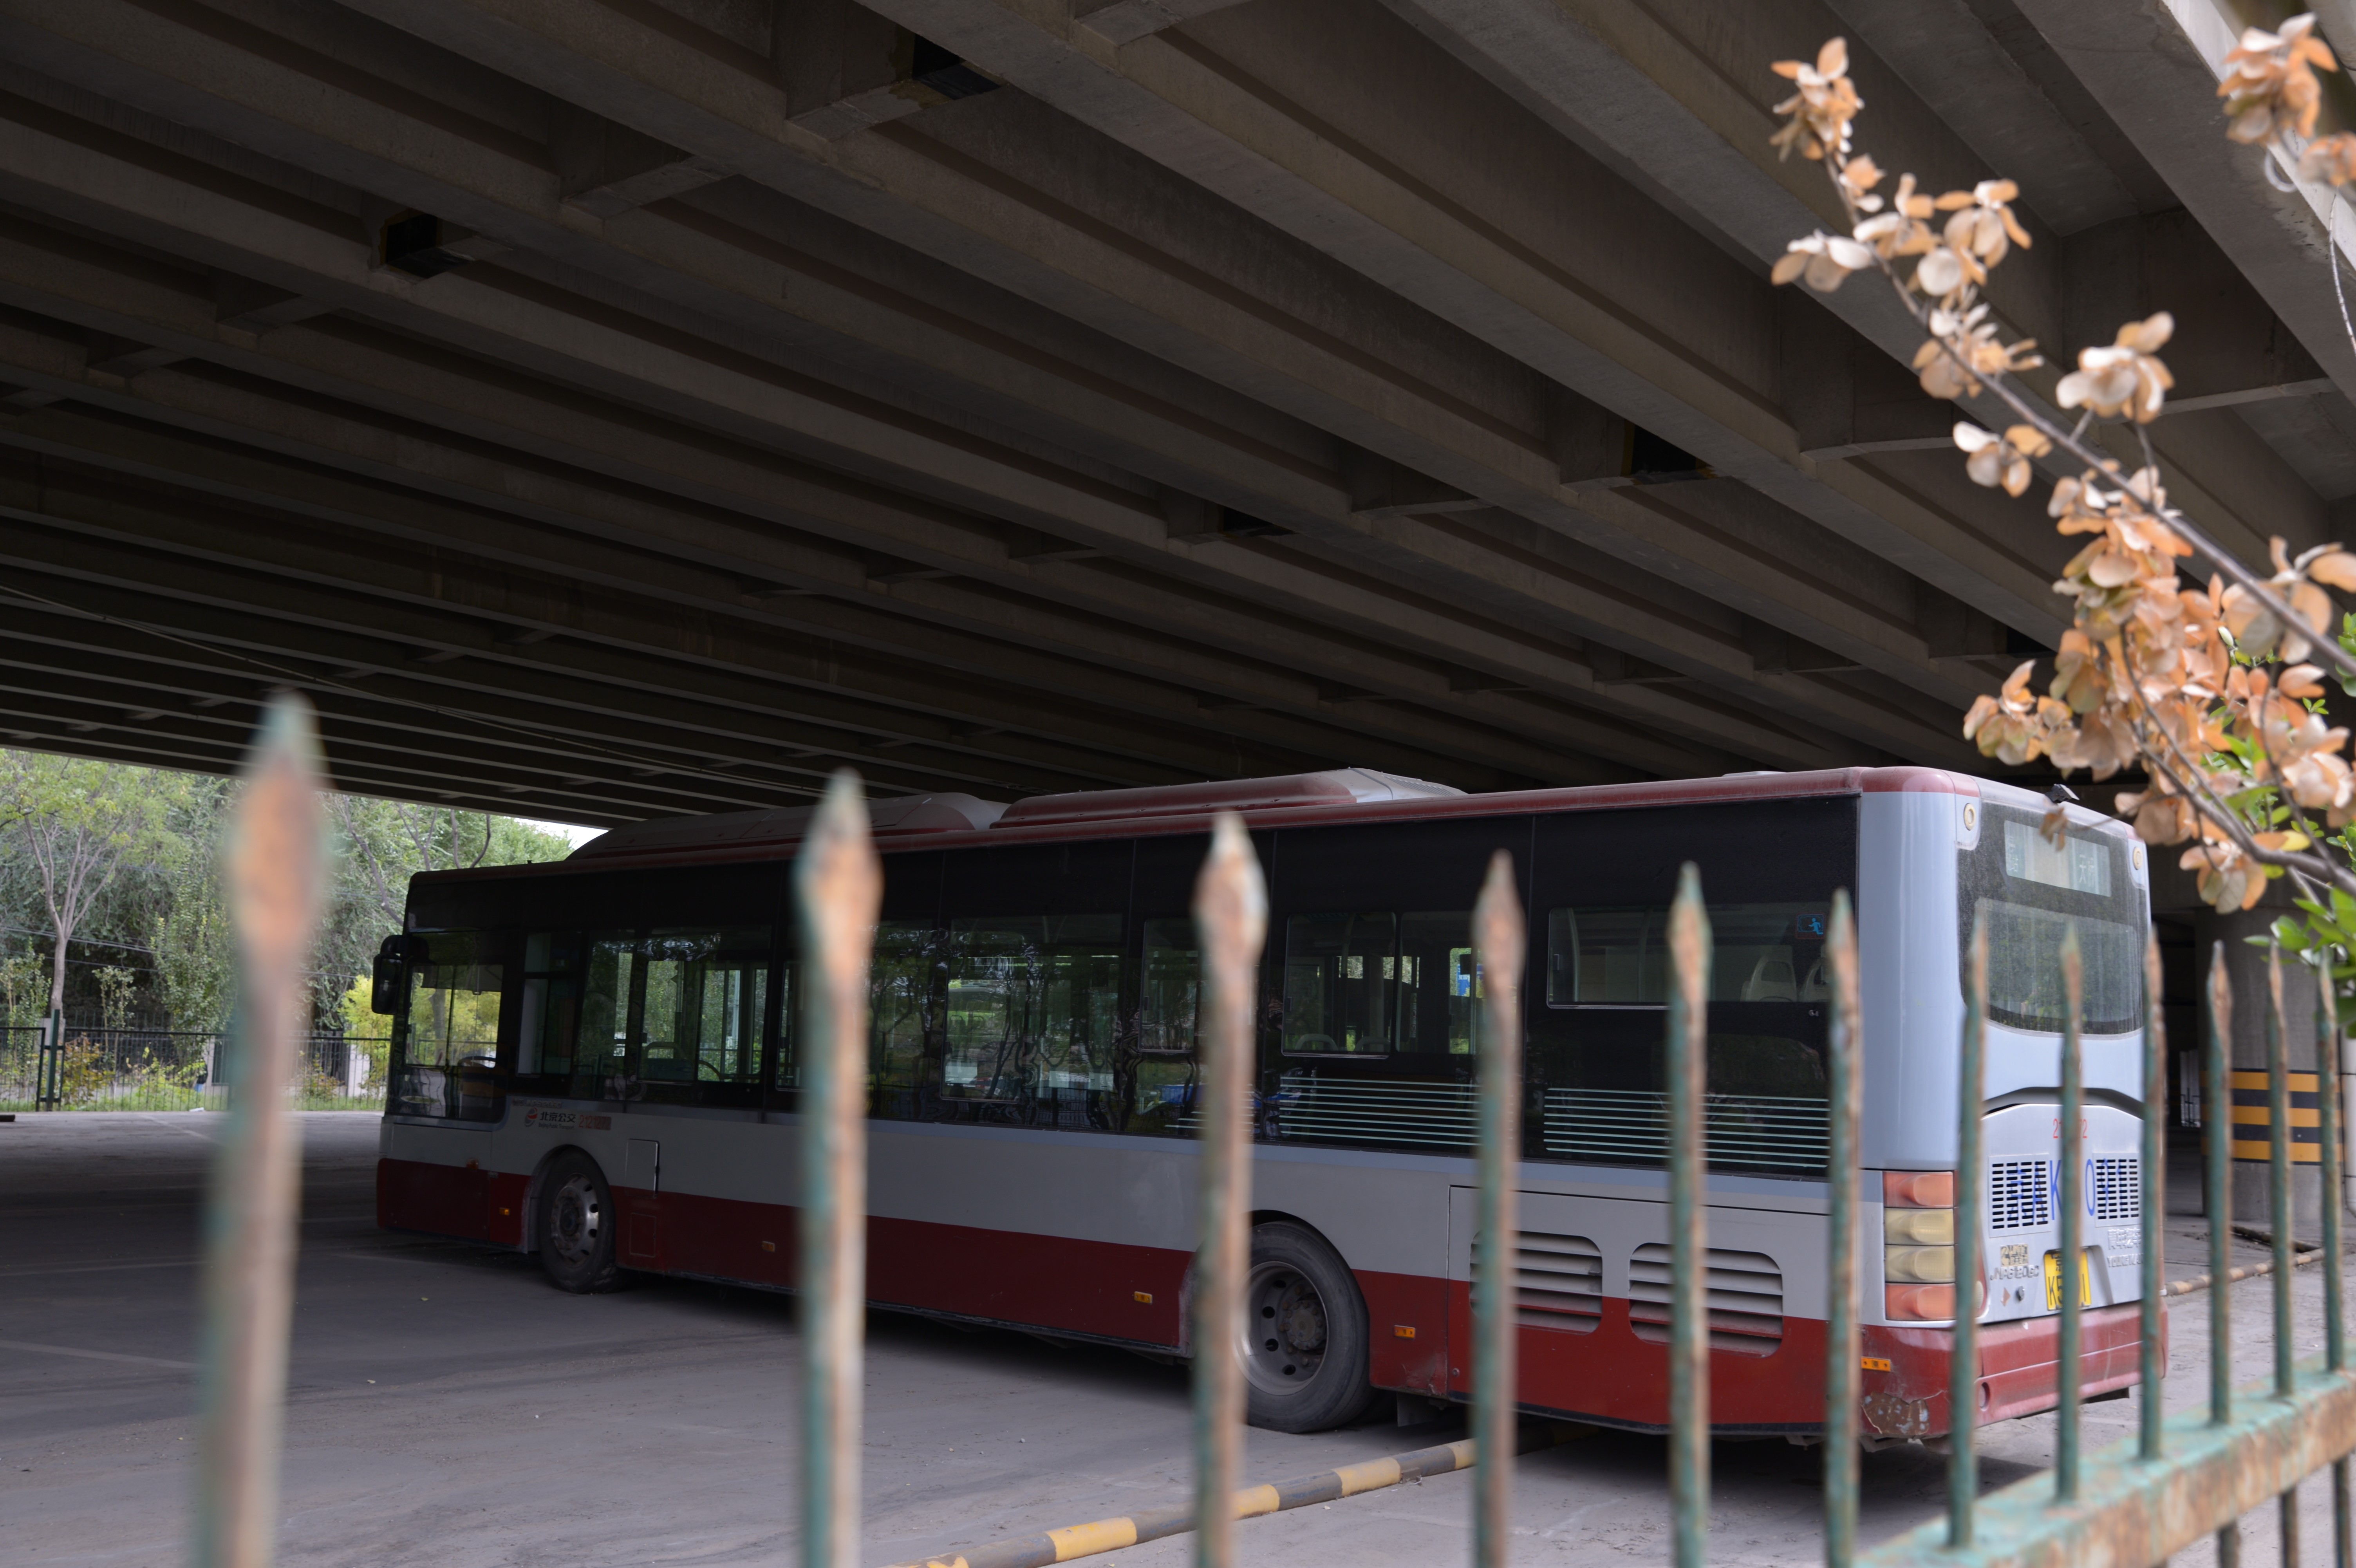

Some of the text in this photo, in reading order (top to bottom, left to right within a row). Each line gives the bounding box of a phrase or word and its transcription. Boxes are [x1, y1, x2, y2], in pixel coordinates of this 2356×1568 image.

[539, 1111, 576, 1123] 北京公交
[579, 1115, 611, 1129] 2121272
